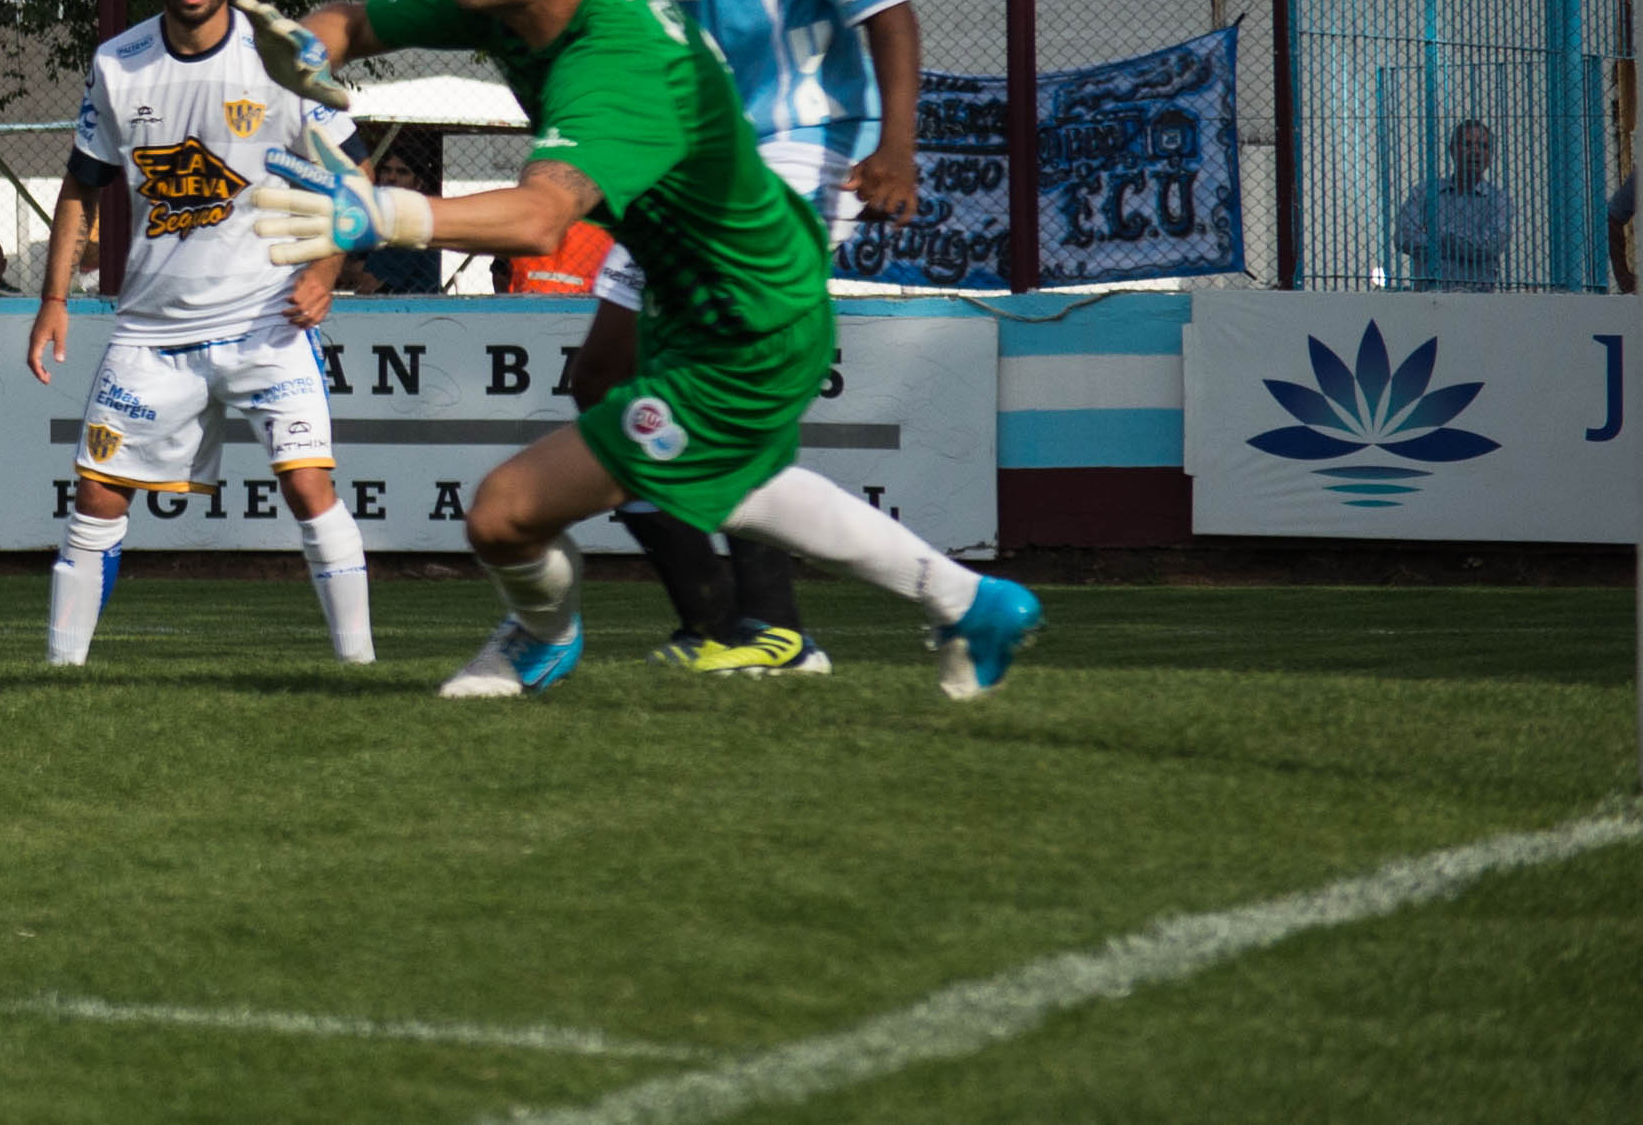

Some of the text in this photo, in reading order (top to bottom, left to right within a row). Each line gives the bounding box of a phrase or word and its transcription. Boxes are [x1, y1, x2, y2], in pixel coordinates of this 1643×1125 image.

[176, 154, 206, 174] LA
[156, 176, 230, 199] NUEVA
[96, 390, 157, 421] Energía
[52, 480, 387, 520] HGIEE
